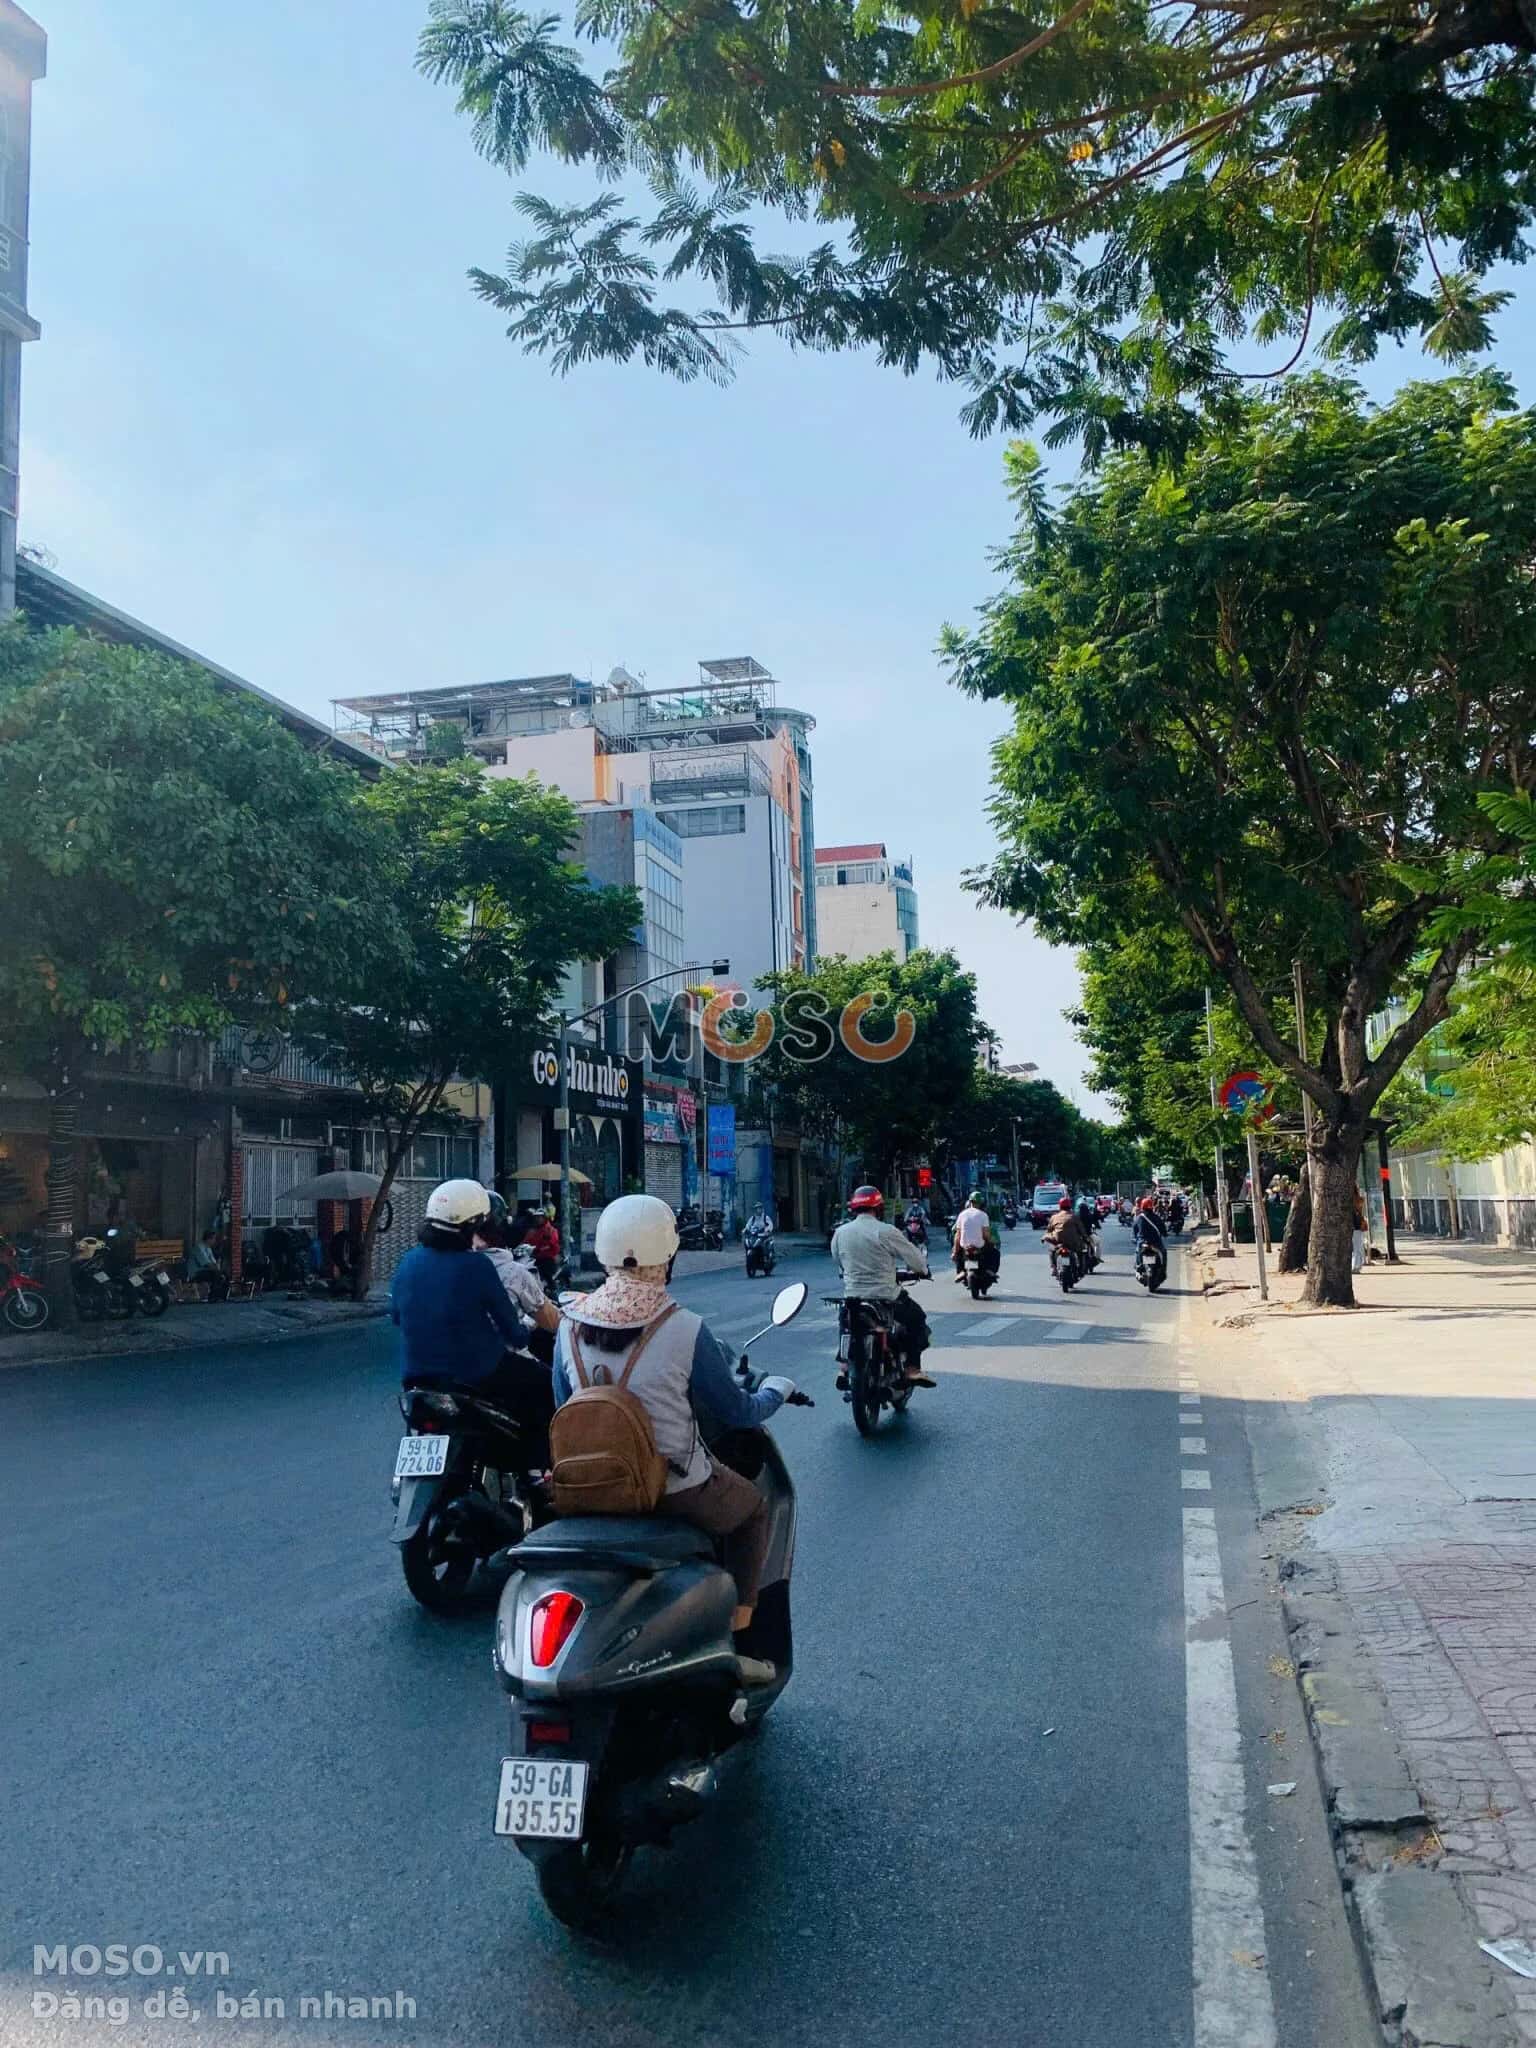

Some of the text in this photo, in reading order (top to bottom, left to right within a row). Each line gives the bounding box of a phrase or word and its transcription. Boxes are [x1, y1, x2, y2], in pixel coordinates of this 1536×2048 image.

[597, 1055, 629, 1098] nhỏ
[511, 1763, 573, 1798] 59-GA
[503, 1799, 577, 1834] 135.55
